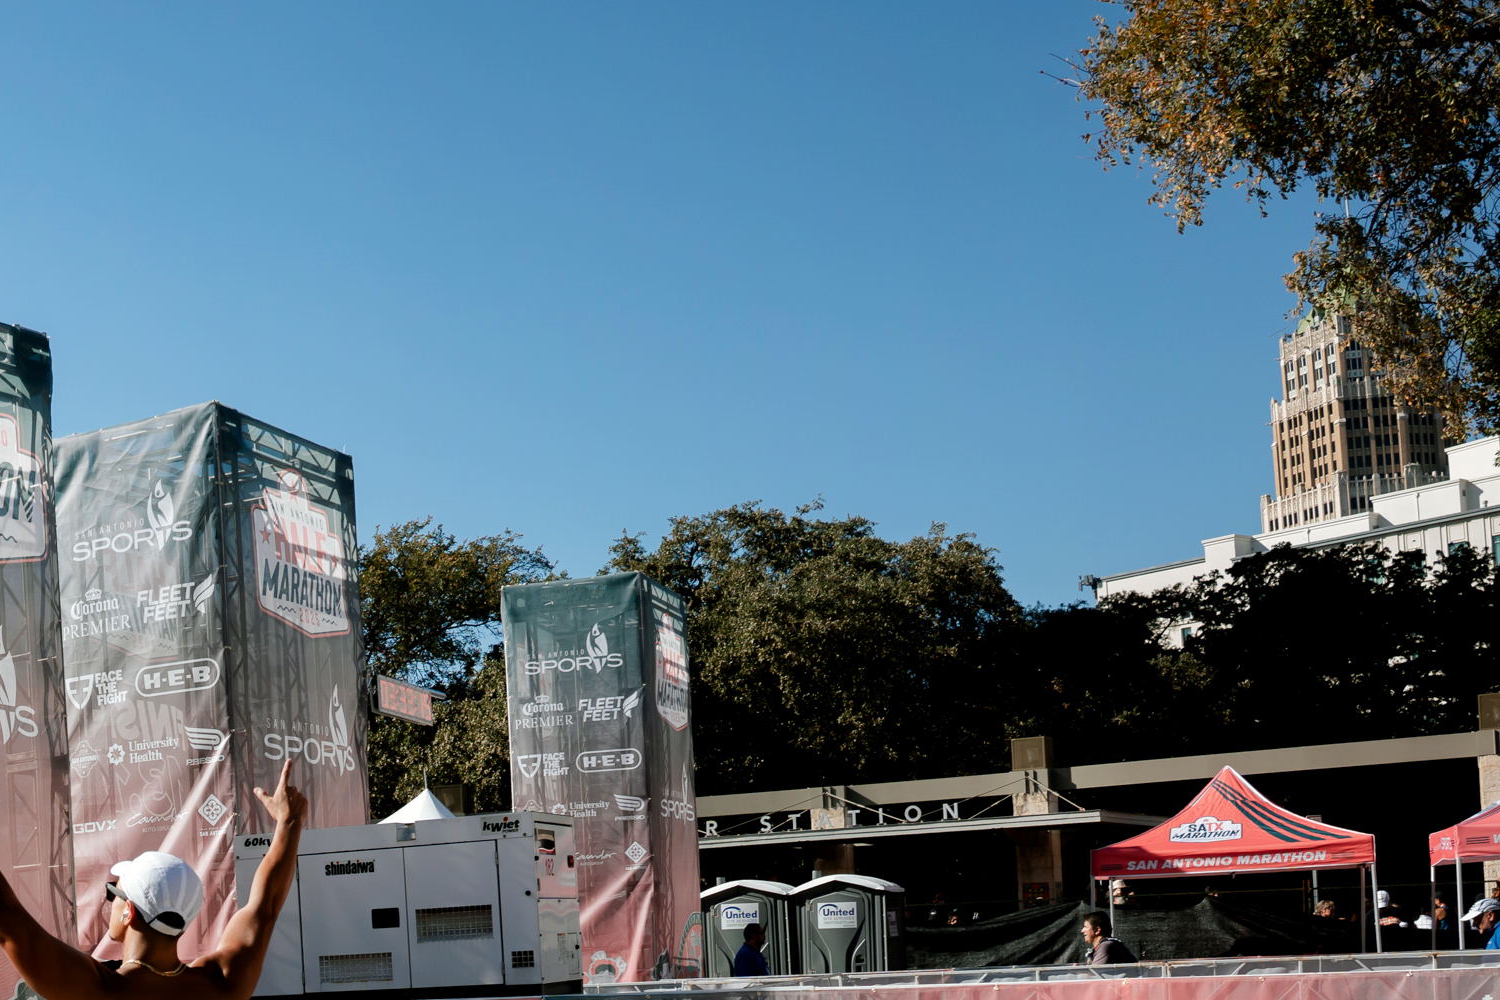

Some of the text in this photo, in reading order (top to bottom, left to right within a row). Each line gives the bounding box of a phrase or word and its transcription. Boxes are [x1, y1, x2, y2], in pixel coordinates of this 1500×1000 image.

[74, 517, 145, 541] SAN ANTONIO
[72, 520, 193, 562] SPORTS
[274, 517, 327, 575] HALF
[136, 582, 195, 608] FLEET
[262, 558, 342, 618] MARATHON
[70, 597, 121, 622] Corona
[143, 600, 191, 624] FEET
[62, 614, 132, 641] PREMIER
[547, 648, 585, 659] ANTONIO
[524, 652, 624, 676] SPORTS
[94, 669, 123, 683] FACE
[95, 682, 117, 695] THE
[97, 690, 128, 707] FIGHT
[578, 695, 624, 711] FLEET
[522, 702, 564, 717] Corona
[583, 708, 621, 722] FEET
[266, 717, 329, 737] SAN ANTONIO
[515, 714, 574, 730] PREMIER
[128, 736, 180, 752] University
[129, 749, 163, 764] Health
[264, 733, 356, 774] SPORTS
[543, 752, 565, 761] FACE
[543, 760, 560, 768] THE
[543, 767, 569, 777] FIGHT
[569, 800, 611, 810] University
[569, 808, 597, 818] Health
[660, 799, 695, 823] SPORTS
[482, 816, 520, 833] kwiet
[760, 803, 959, 834] STATION
[72, 819, 118, 835] GOVX
[1171, 829, 1240, 840] MARATHON
[1188, 822, 1223, 833] SATX
[325, 859, 375, 876] shindaiwa
[1127, 851, 1327, 871] SAN ANTONIO MARATHON
[725, 910, 758, 919] United
[822, 907, 855, 917] United
